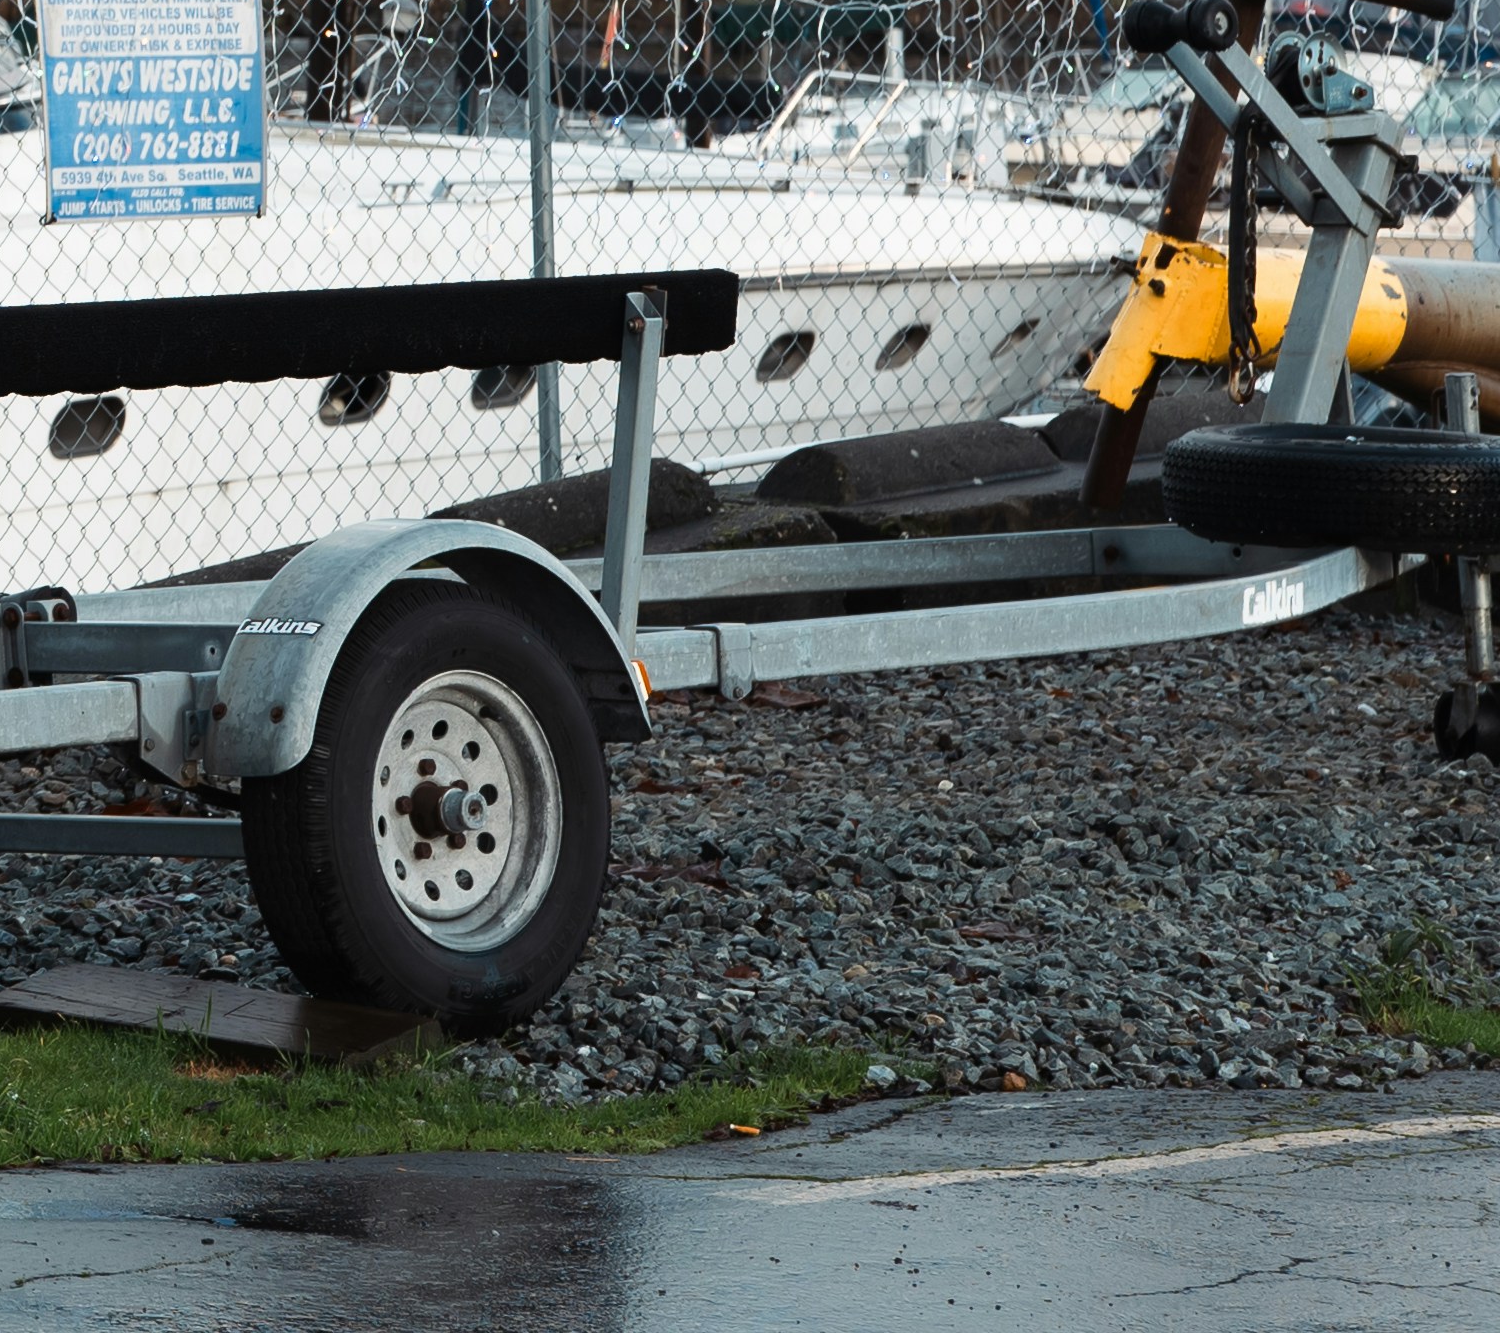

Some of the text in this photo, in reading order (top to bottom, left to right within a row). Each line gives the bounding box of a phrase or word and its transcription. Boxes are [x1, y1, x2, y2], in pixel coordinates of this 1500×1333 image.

[120, 8, 181, 20] VEHICLES
[185, 8, 212, 19] WILL
[218, 7, 233, 19] BE
[61, 23, 240, 36] IMPOUNDED 24 HOURS A DAY
[61, 41, 75, 53] AT
[80, 40, 136, 52] OWNER'S
[174, 39, 181, 50] &
[187, 39, 242, 50] EXPENSE
[53, 57, 254, 96] GARY'S WESTSIDE
[77, 98, 236, 129] TOWING, L.L.C.
[73, 130, 240, 164] (206) 762-8881
[61, 172, 92, 185] 5939
[121, 172, 144, 183] Ave
[178, 168, 228, 181] Seattle,
[233, 167, 253, 179] WA
[59, 202, 86, 216] JUMP
[136, 198, 181, 212] UNLOCKS
[192, 198, 213, 210] TIRE
[216, 196, 255, 209] SERVICE
[236, 618, 321, 634] Calkins
